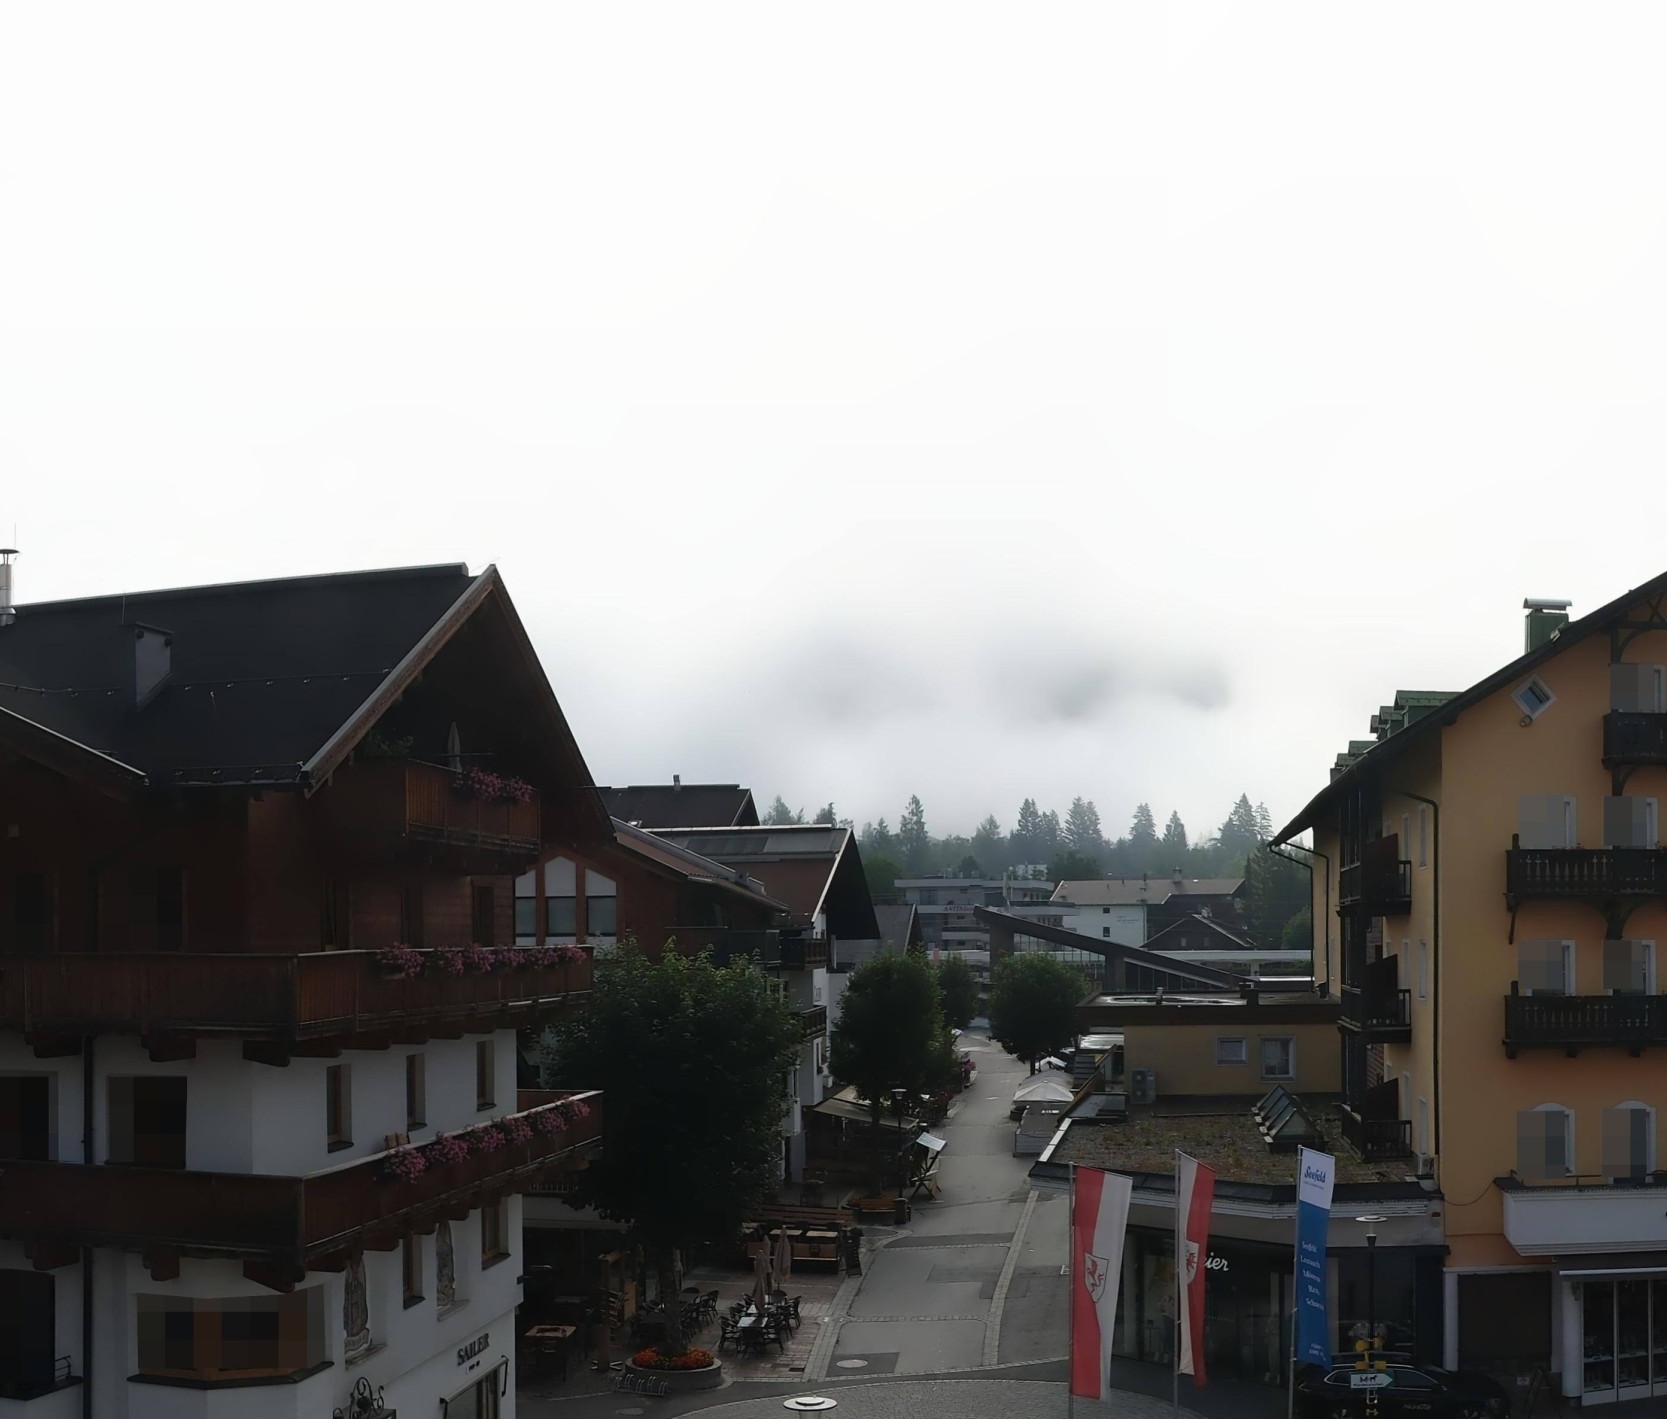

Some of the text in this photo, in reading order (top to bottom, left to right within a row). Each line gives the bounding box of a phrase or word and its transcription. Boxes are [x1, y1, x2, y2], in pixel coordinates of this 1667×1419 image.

[1304, 1166, 1326, 1184] Seefeld
[1204, 1252, 1230, 1272] ier
[457, 1333, 490, 1366] SAILER
